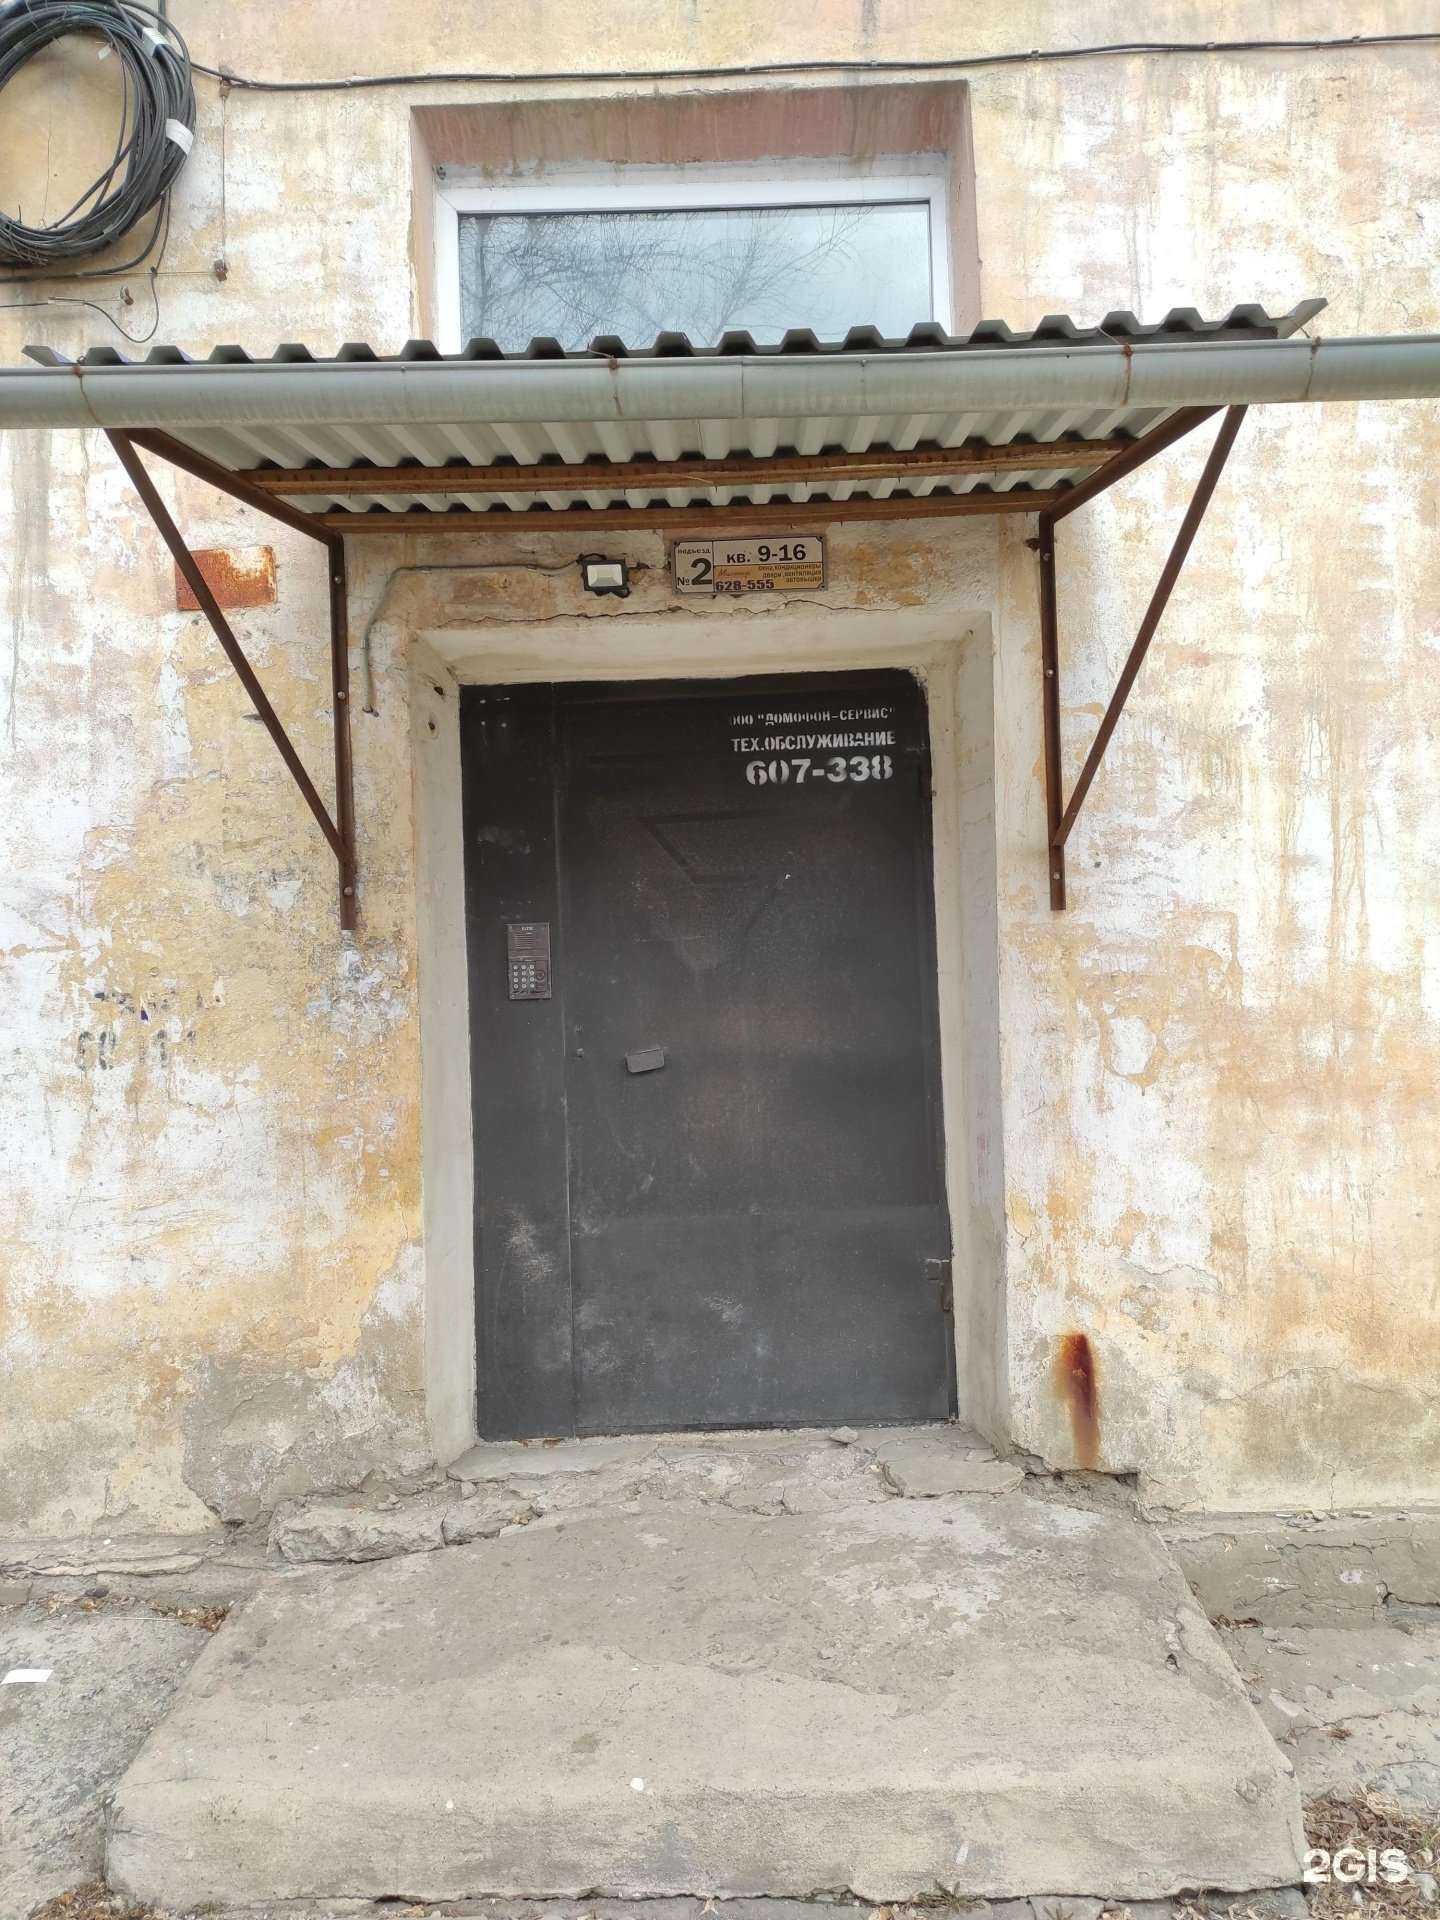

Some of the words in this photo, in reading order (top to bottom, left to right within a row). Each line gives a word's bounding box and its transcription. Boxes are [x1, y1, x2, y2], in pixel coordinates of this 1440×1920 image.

[677, 547, 711, 555] подъезд
[726, 554, 751, 564] кв.
[757, 544, 807, 562] 9-16
[716, 579, 775, 591] 628-555
[745, 754, 894, 786] 607-338
